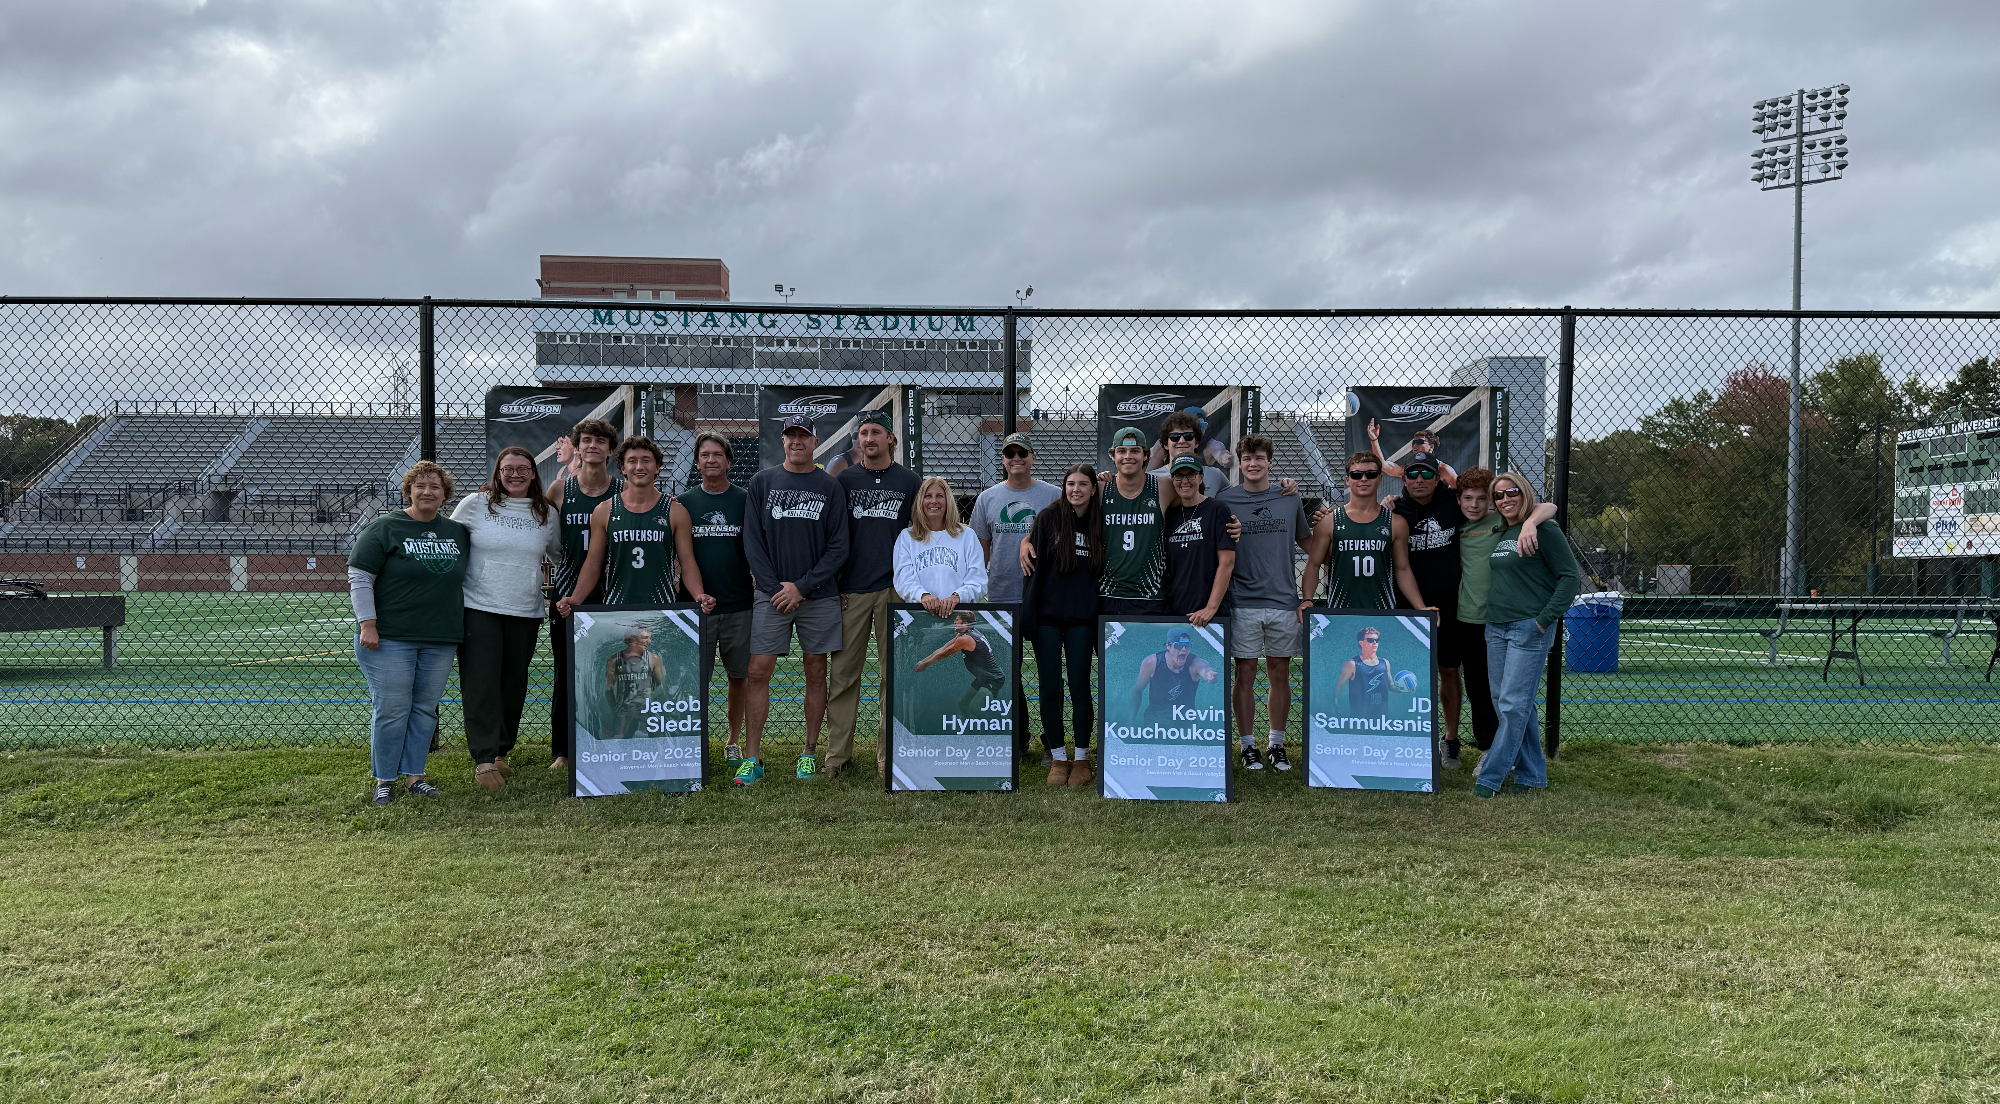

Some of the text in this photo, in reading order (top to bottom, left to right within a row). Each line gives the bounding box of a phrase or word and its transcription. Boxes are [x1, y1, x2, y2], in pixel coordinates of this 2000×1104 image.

[591, 308, 976, 332] MUSTANG STADIUM
[501, 404, 561, 414] STEVENSON
[780, 404, 837, 414] STEVENSON
[1118, 402, 1176, 412] STEVENSON
[1392, 404, 1450, 414] STEVENSON
[1898, 426, 1946, 441] STEVENSON
[1106, 513, 1155, 526] STEVENSON
[613, 530, 664, 542] STEVENSON
[1123, 530, 1134, 550] 9
[403, 542, 460, 554] MUSTANGS
[1338, 540, 1386, 551] STEVENSON
[632, 547, 644, 569] 3
[1353, 556, 1374, 577] 10
[640, 696, 700, 713] Jacob
[981, 696, 1012, 715] Jay
[1408, 697, 1431, 713] JD
[1172, 705, 1225, 721] Kevin
[646, 715, 701, 732] Sledz
[943, 715, 1012, 735] Hyman
[1315, 713, 1431, 732] Sarmuksnis
[1105, 722, 1225, 741] Kouchoukos
[582, 747, 701, 763] Senior Day 2025
[898, 746, 1012, 760] Senior Day 2025
[1315, 744, 1432, 760] Senior Day 2025
[1110, 754, 1225, 770] Senior Day 2025
